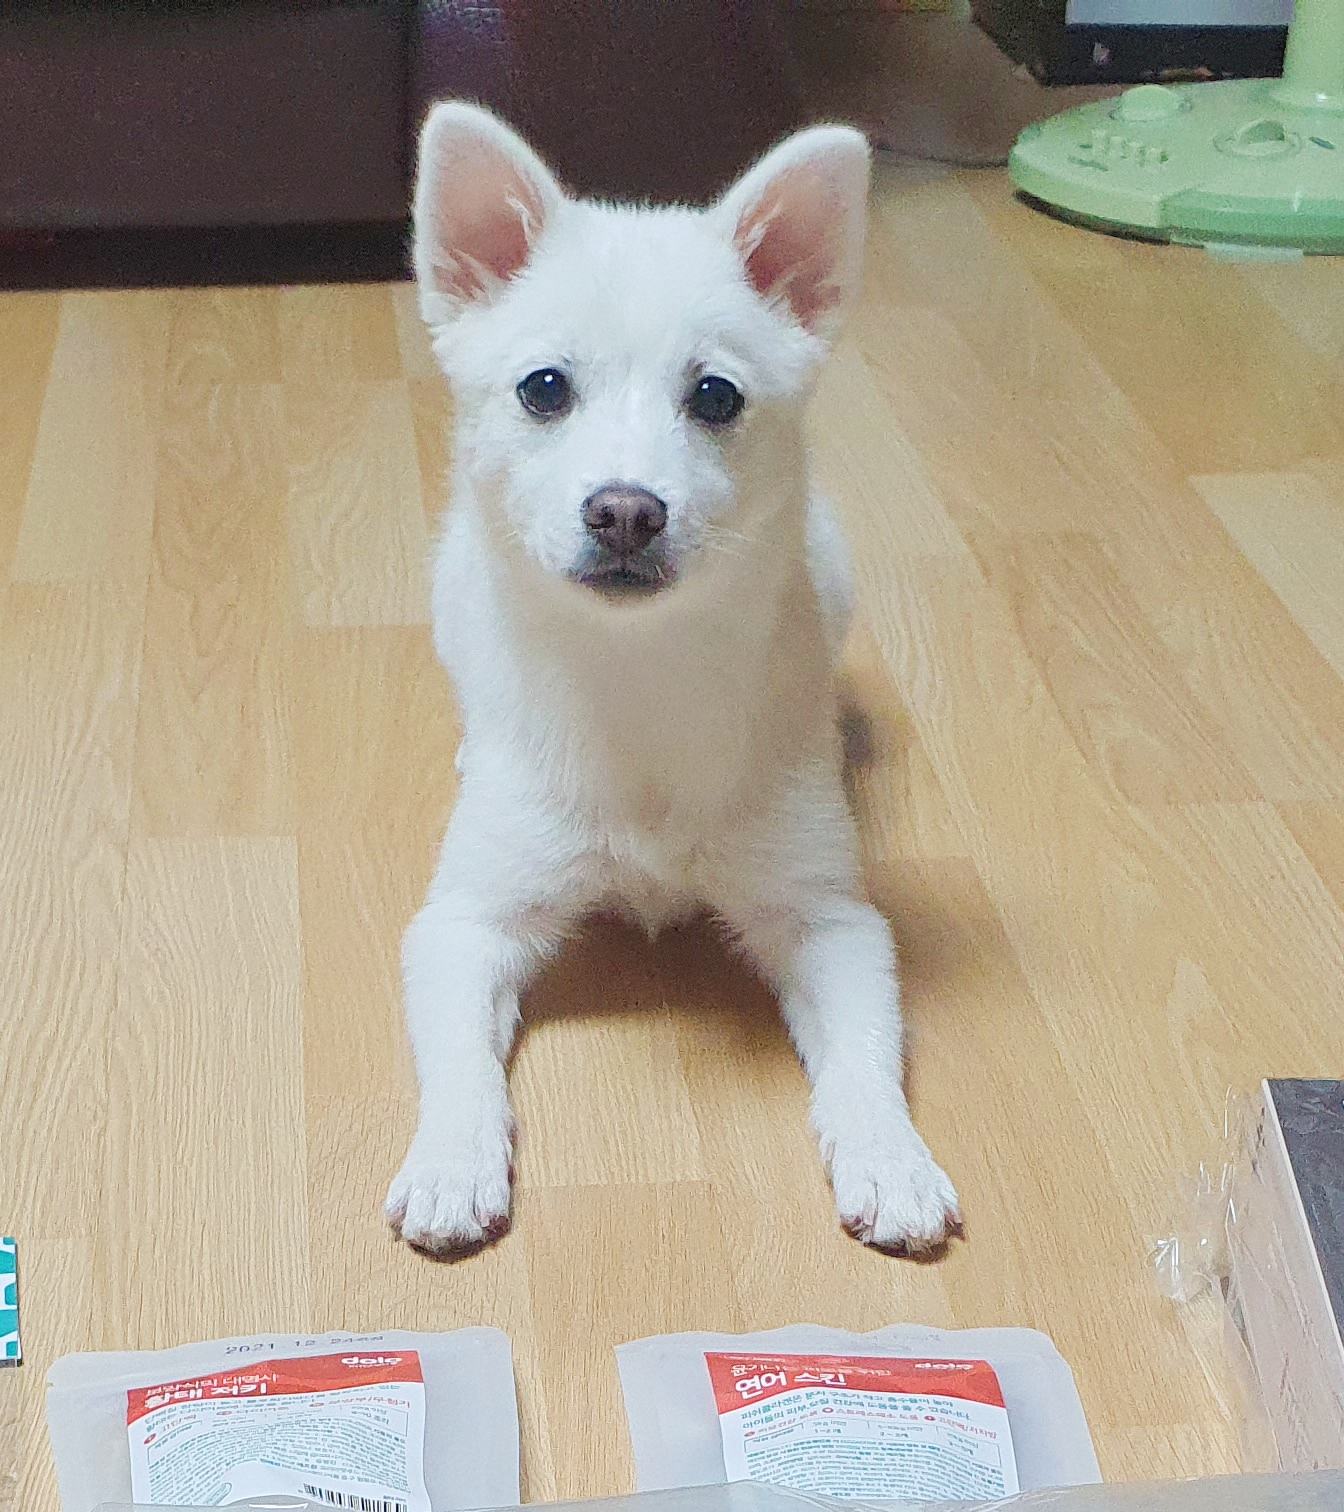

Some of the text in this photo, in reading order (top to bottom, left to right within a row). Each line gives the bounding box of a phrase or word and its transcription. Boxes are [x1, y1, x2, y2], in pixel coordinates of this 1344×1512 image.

[211, 1382, 267, 1396] 저키
[735, 1371, 847, 1400] 연어 스킨
